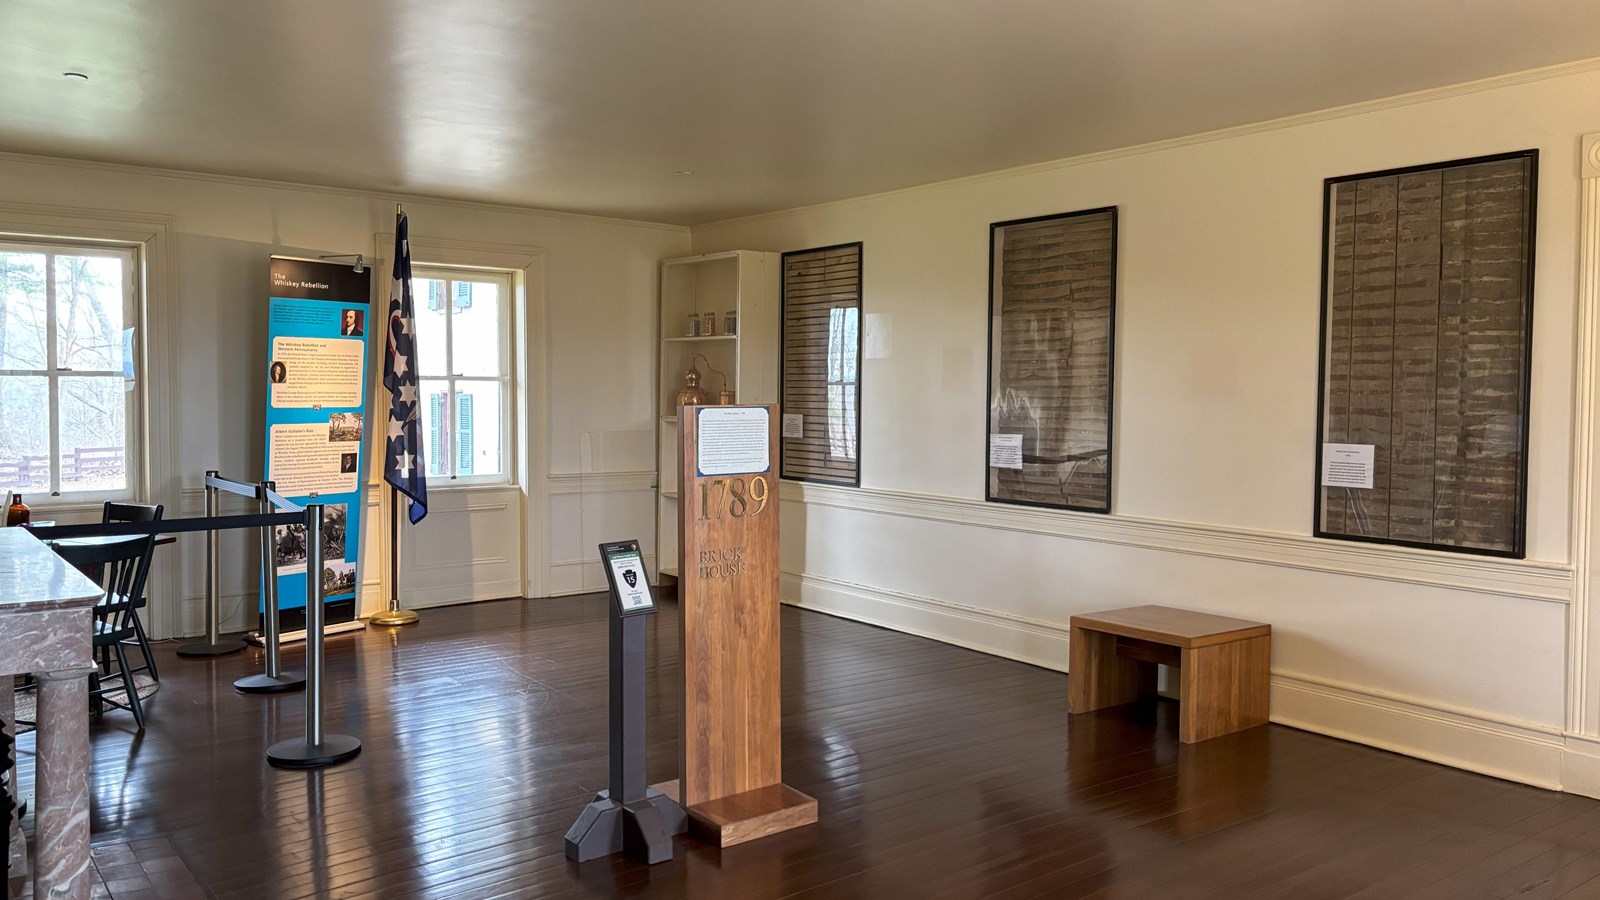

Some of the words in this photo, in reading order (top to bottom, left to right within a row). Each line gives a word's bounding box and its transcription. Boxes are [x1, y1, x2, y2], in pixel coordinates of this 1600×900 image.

[274, 280, 300, 288] Whiskey
[301, 281, 329, 289] Rebellion
[698, 476, 769, 521] 1789
[699, 547, 743, 563] BRICK
[699, 562, 747, 580] HOUSE
[627, 576, 635, 584] 15
